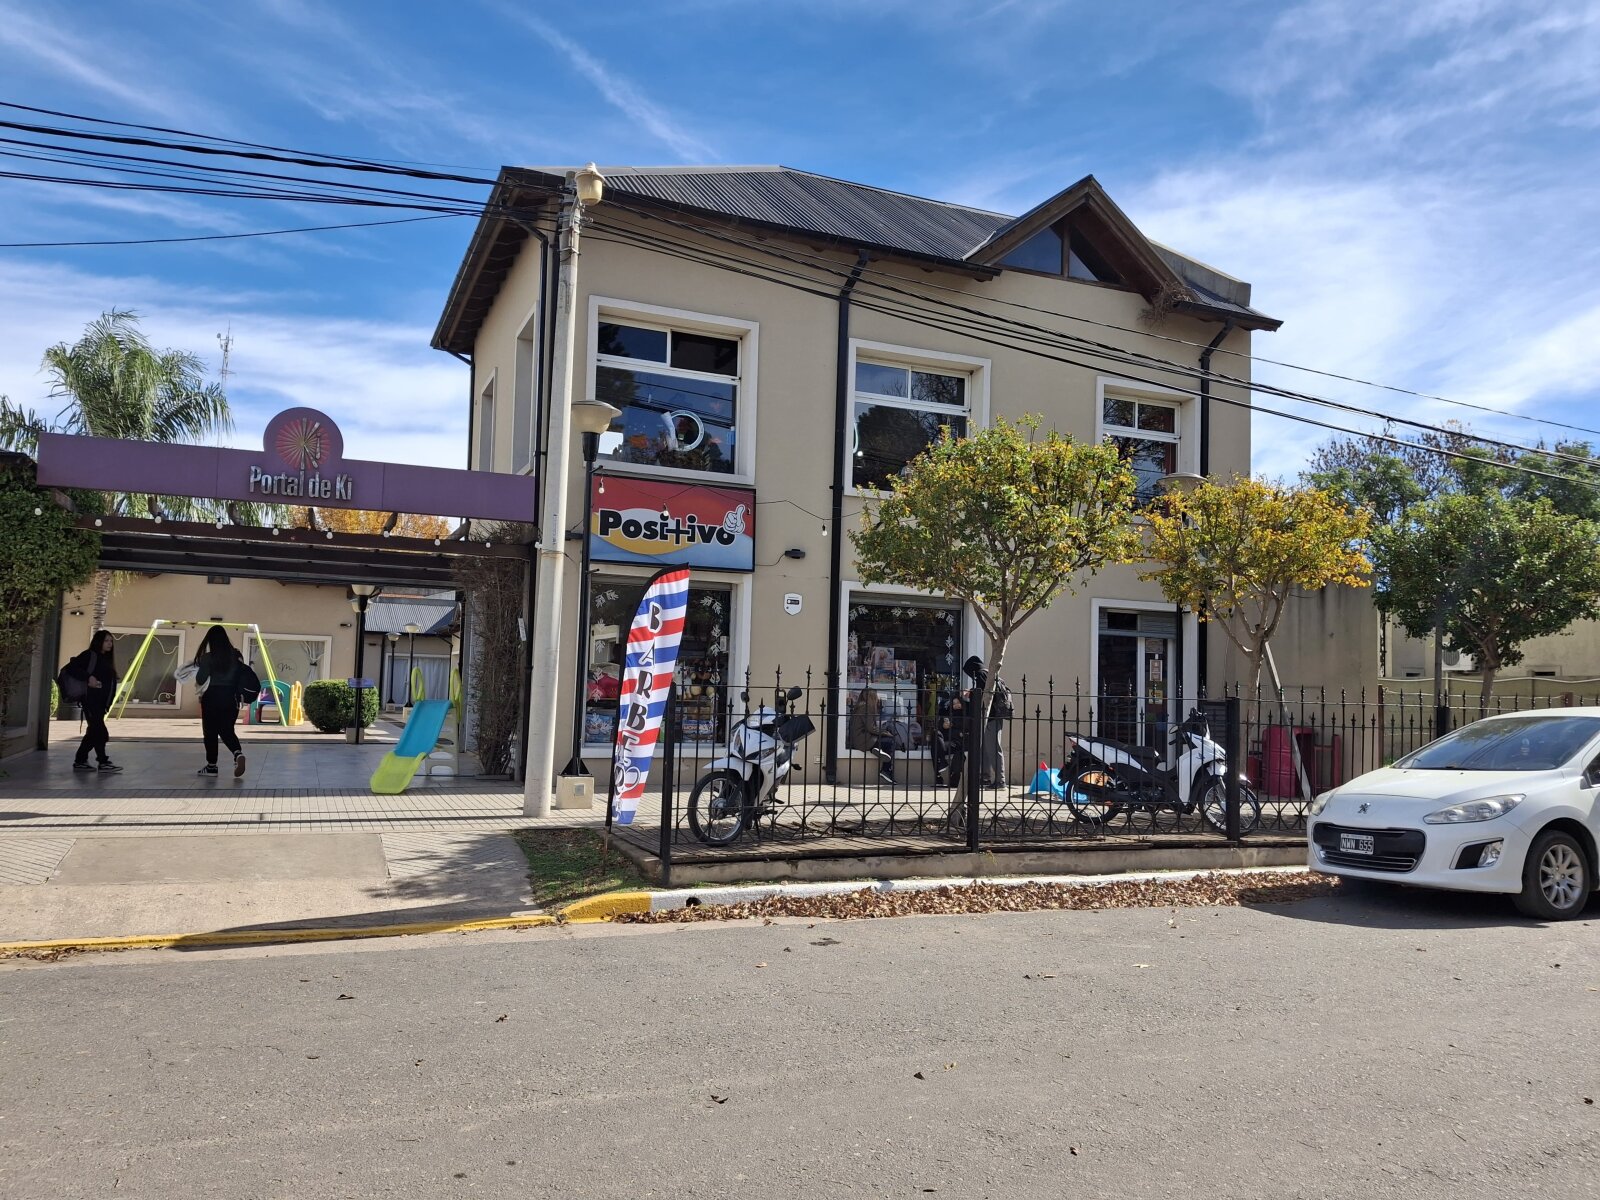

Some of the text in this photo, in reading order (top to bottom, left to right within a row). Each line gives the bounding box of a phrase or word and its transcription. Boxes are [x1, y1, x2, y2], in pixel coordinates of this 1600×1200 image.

[249, 465, 353, 500] Portal de Ki
